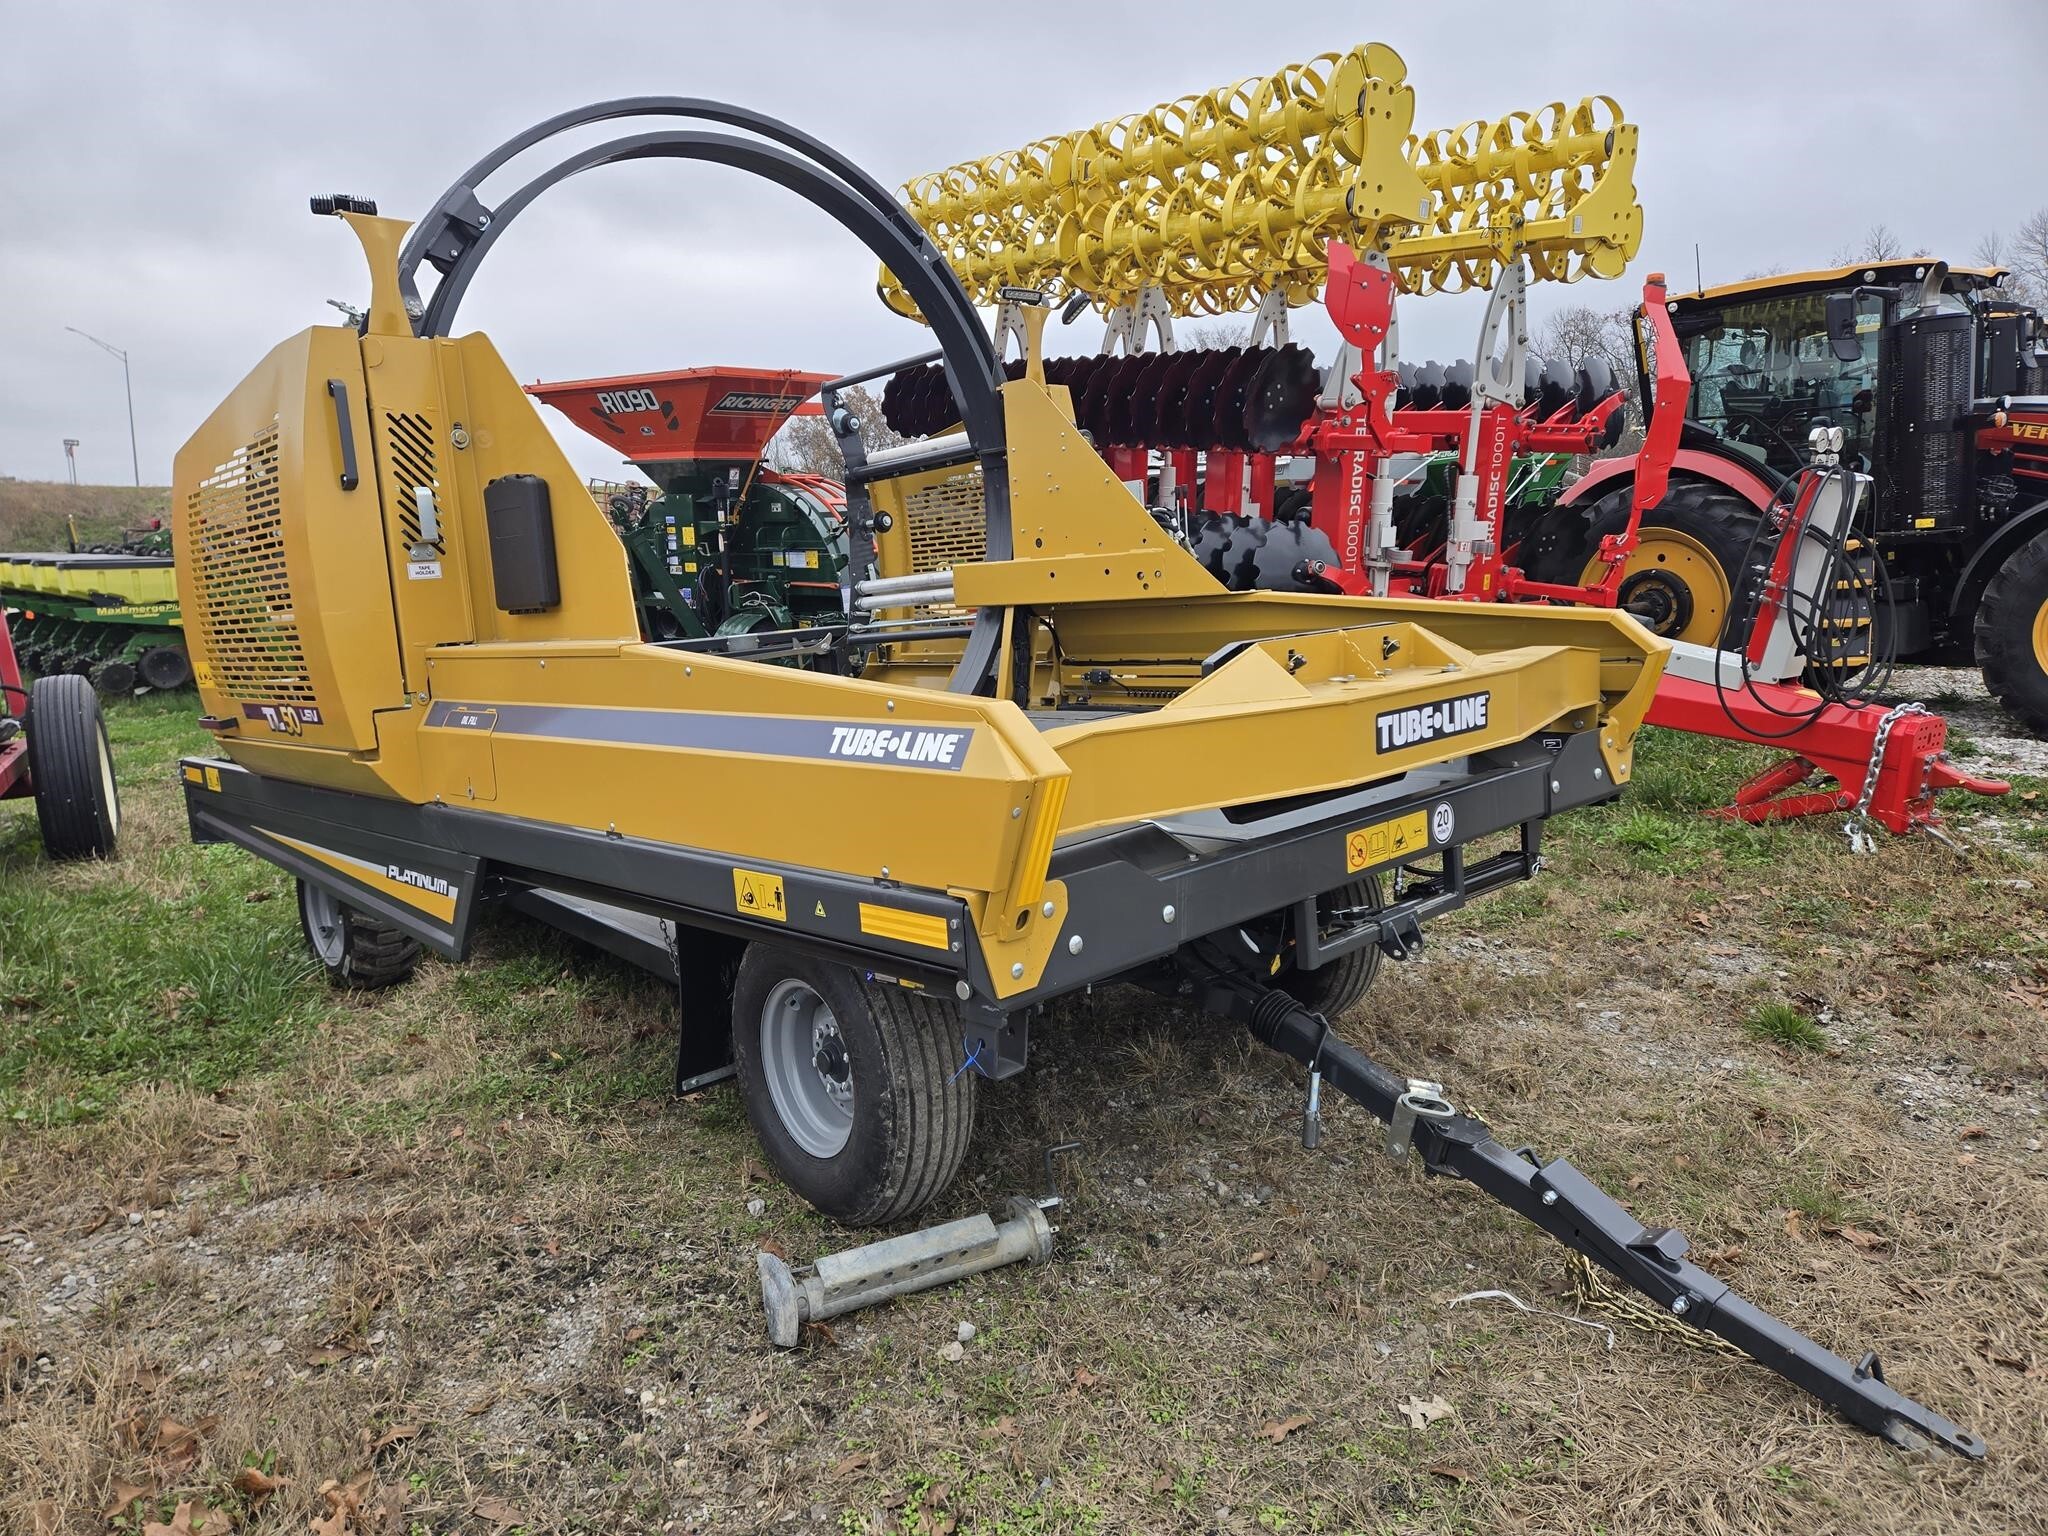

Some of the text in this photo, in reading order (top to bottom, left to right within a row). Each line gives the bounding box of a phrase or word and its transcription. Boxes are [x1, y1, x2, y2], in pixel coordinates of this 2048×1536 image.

[720, 396, 798, 411] RICHIGER
[1349, 414, 1367, 516] TERADISC
[1482, 471, 1501, 565] TRRADISC
[1436, 809, 1450, 828] 20
[388, 864, 449, 895] PLATINUM
